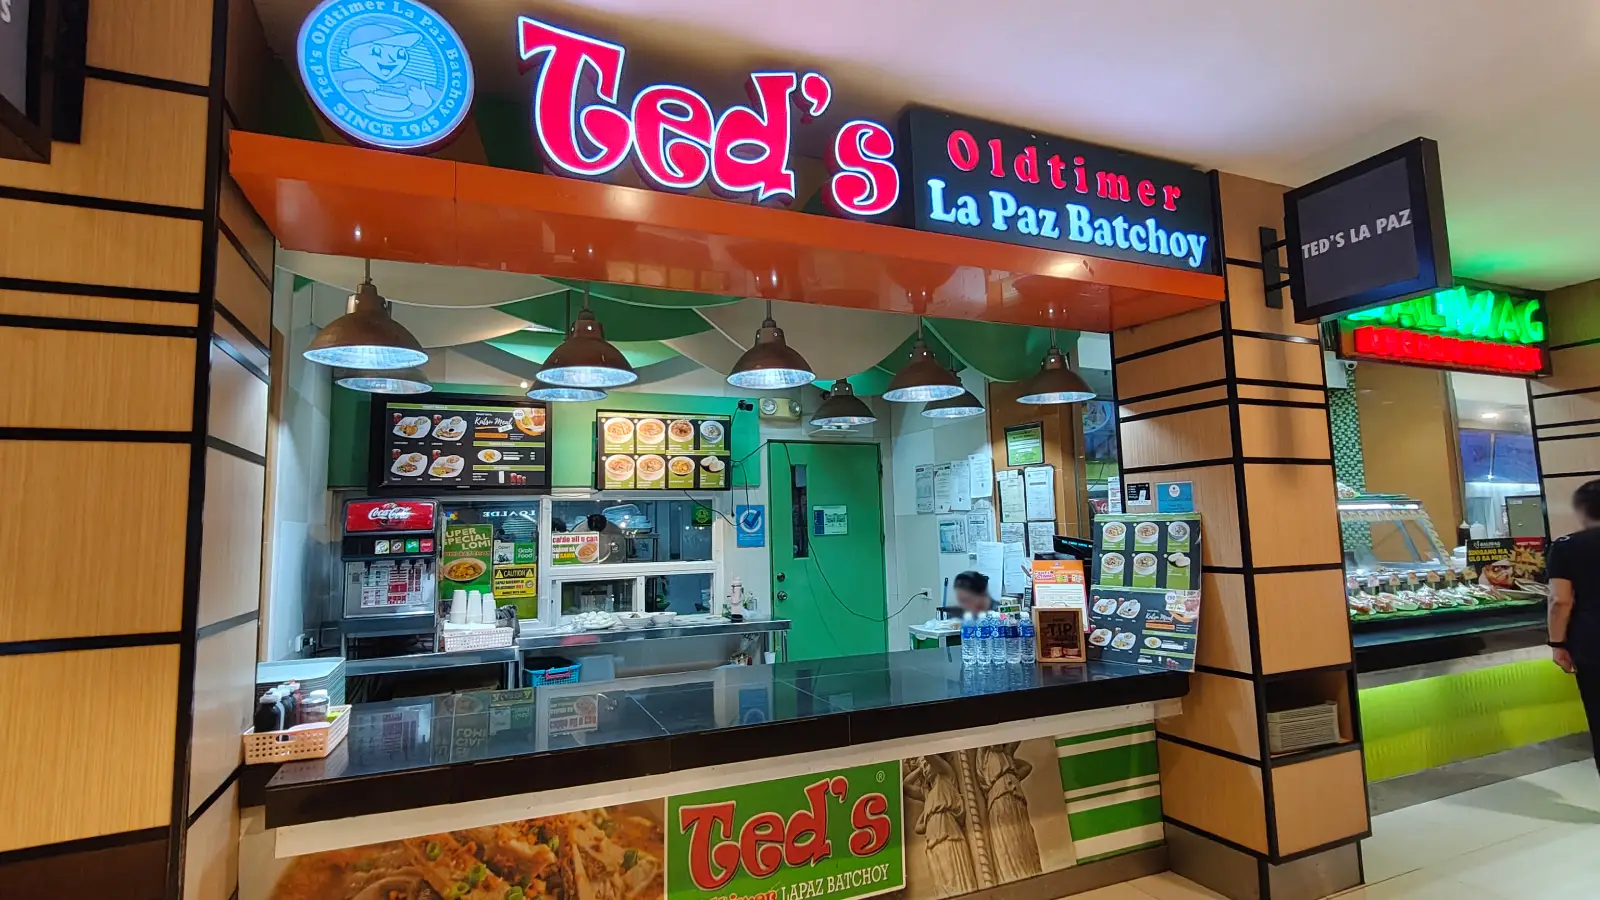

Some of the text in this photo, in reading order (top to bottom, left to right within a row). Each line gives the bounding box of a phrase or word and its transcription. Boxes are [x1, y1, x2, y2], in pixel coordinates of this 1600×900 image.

[309, 1, 463, 118] Ted's Oldtimer La Paz Batchoy
[333, 102, 440, 137] SINCE 1945
[517, 16, 900, 216] Ted's
[947, 129, 1181, 212] Oldtimer
[927, 178, 1207, 268] La Paz Batchoy
[1301, 208, 1412, 259] TED'S LA PAZ
[445, 528, 476, 538] UPER
[461, 540, 491, 550] LOMI
[503, 569, 525, 577] CAUTION
[679, 776, 891, 891] Ted's
[780, 864, 890, 900] LAPAZ BATCHOY
